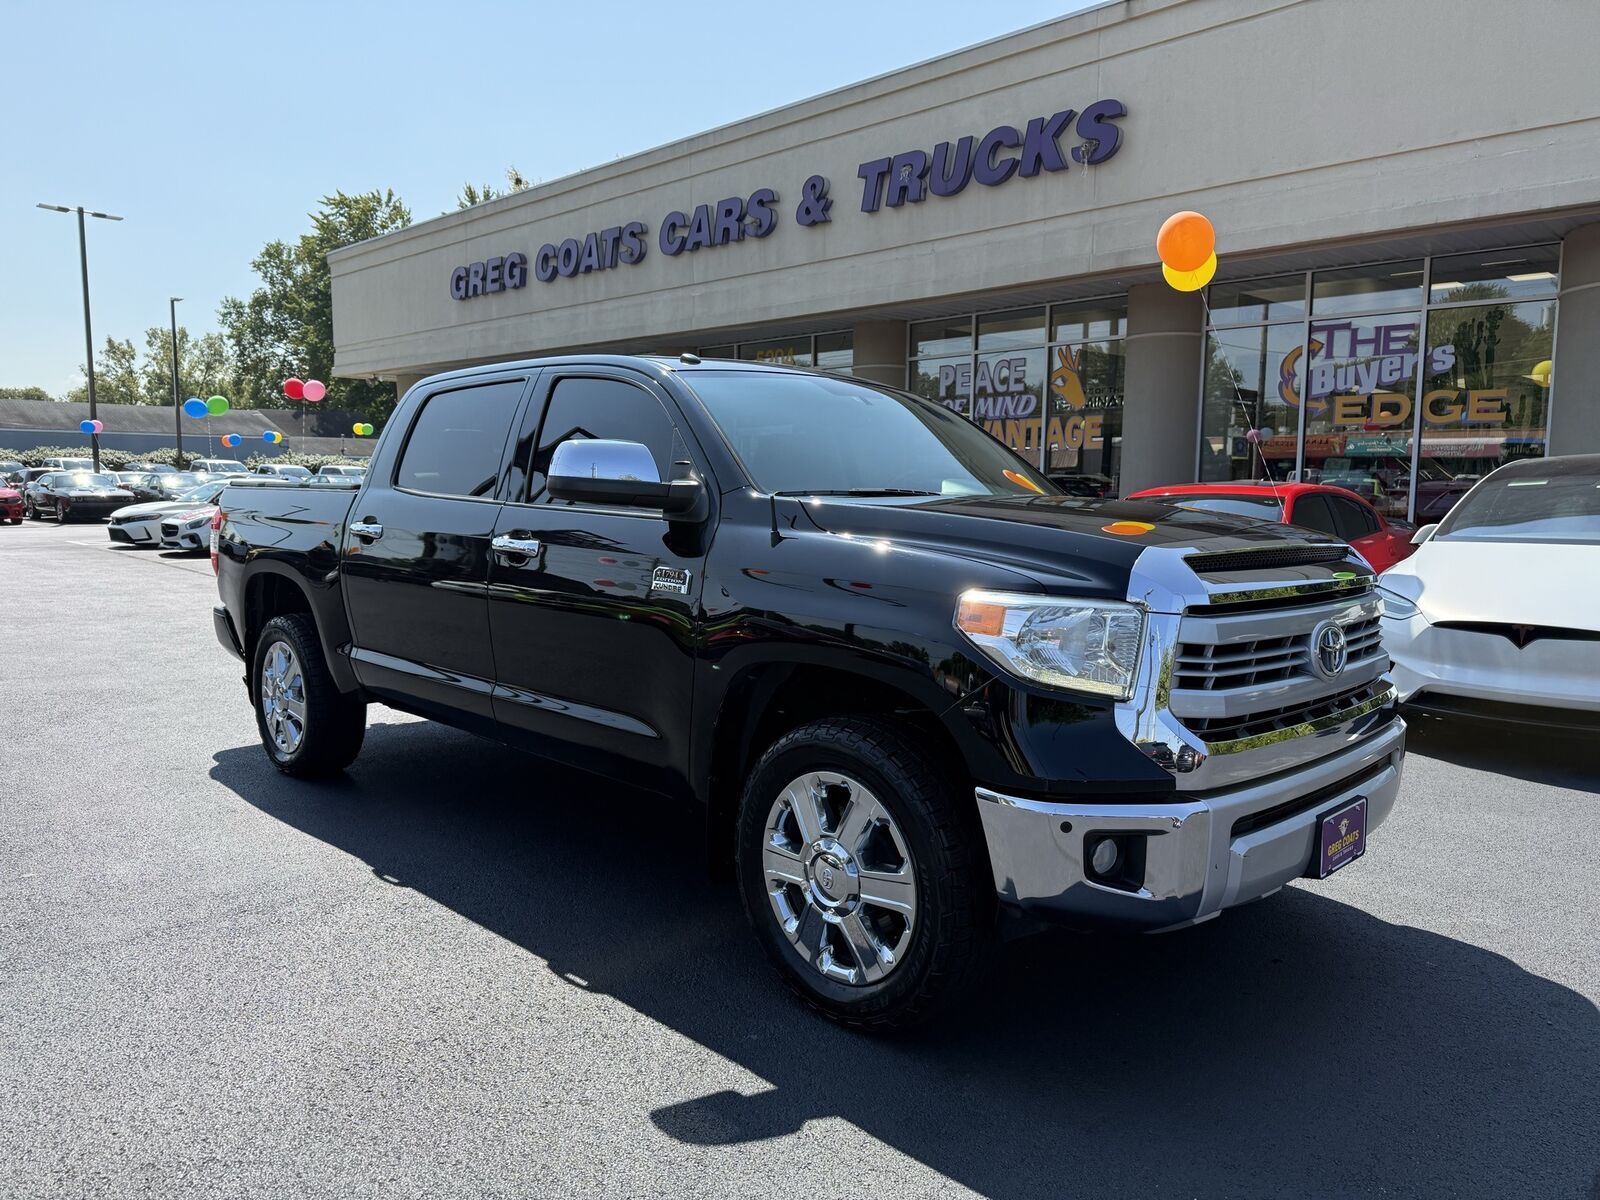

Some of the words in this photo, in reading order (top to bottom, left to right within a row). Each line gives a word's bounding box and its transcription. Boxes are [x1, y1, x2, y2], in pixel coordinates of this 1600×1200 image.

[449, 252, 528, 300] GREG
[535, 221, 648, 282] COATS
[658, 187, 780, 257] CARS
[796, 174, 833, 226] &
[857, 98, 1127, 214] TRUCKS
[1311, 320, 1420, 361] THE
[938, 357, 1027, 397] PEACE
[974, 394, 1038, 420] MIND
[1331, 388, 1508, 425] EDGE
[1328, 839, 1343, 857] GREG
[1342, 830, 1360, 846] COATS
